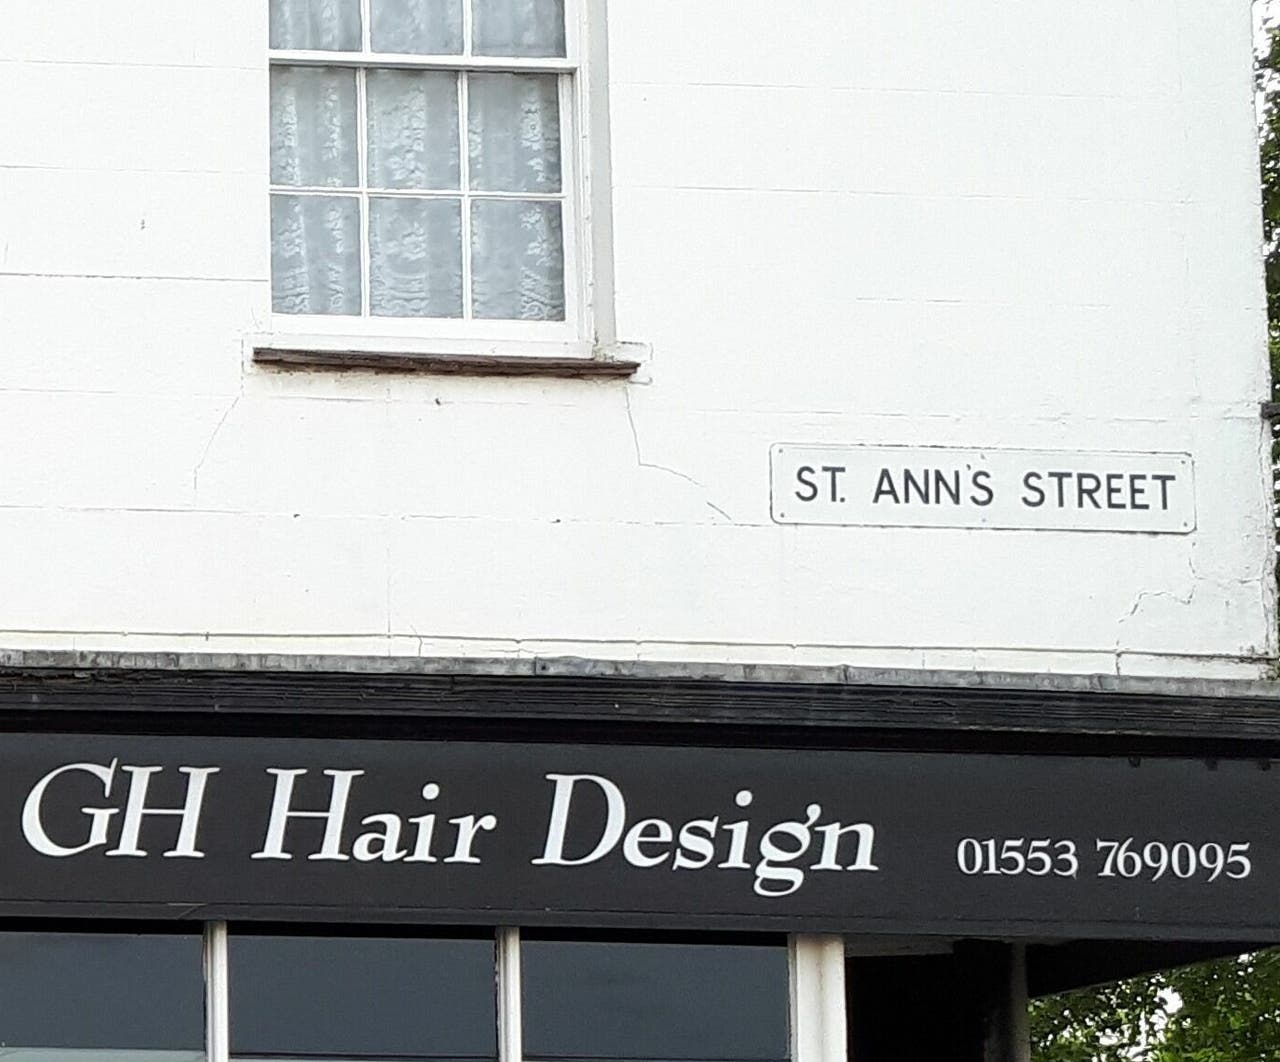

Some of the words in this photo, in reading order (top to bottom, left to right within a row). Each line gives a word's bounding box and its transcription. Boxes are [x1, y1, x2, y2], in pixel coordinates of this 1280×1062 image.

[794, 465, 846, 503] ST.
[873, 463, 994, 508] ANN'S
[1021, 471, 1176, 511] STREET
[20, 756, 221, 859] GH
[250, 767, 498, 865] Hair
[530, 772, 880, 898] Design
[956, 837, 1080, 878] 01553
[1095, 836, 1252, 882] 769095
